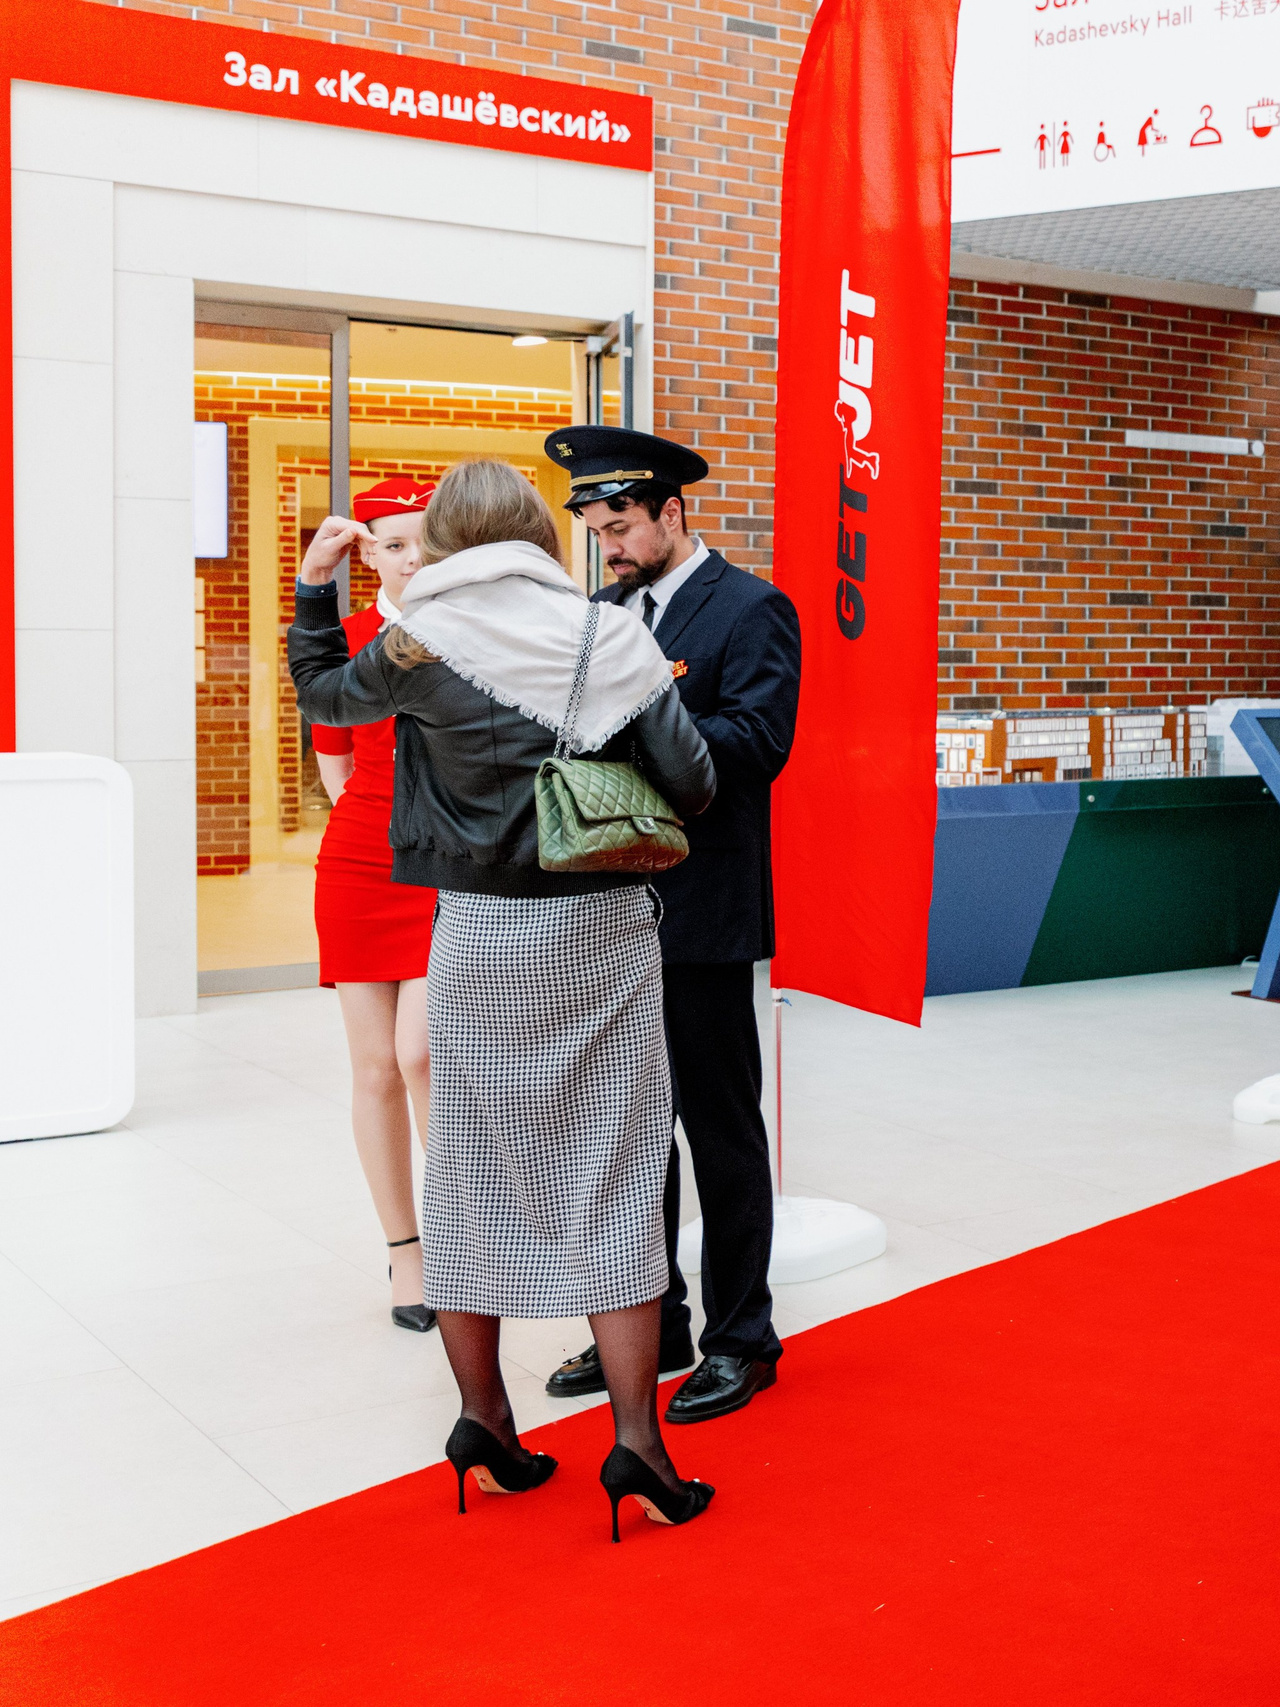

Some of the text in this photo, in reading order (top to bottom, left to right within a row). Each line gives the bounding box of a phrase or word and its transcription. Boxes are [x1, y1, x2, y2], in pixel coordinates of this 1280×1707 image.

[1034, 6, 1192, 48] Kadashevsky Hall
[223, 51, 631, 144] Зал «Кадашёвский»
[836, 268, 876, 641] GET JET
